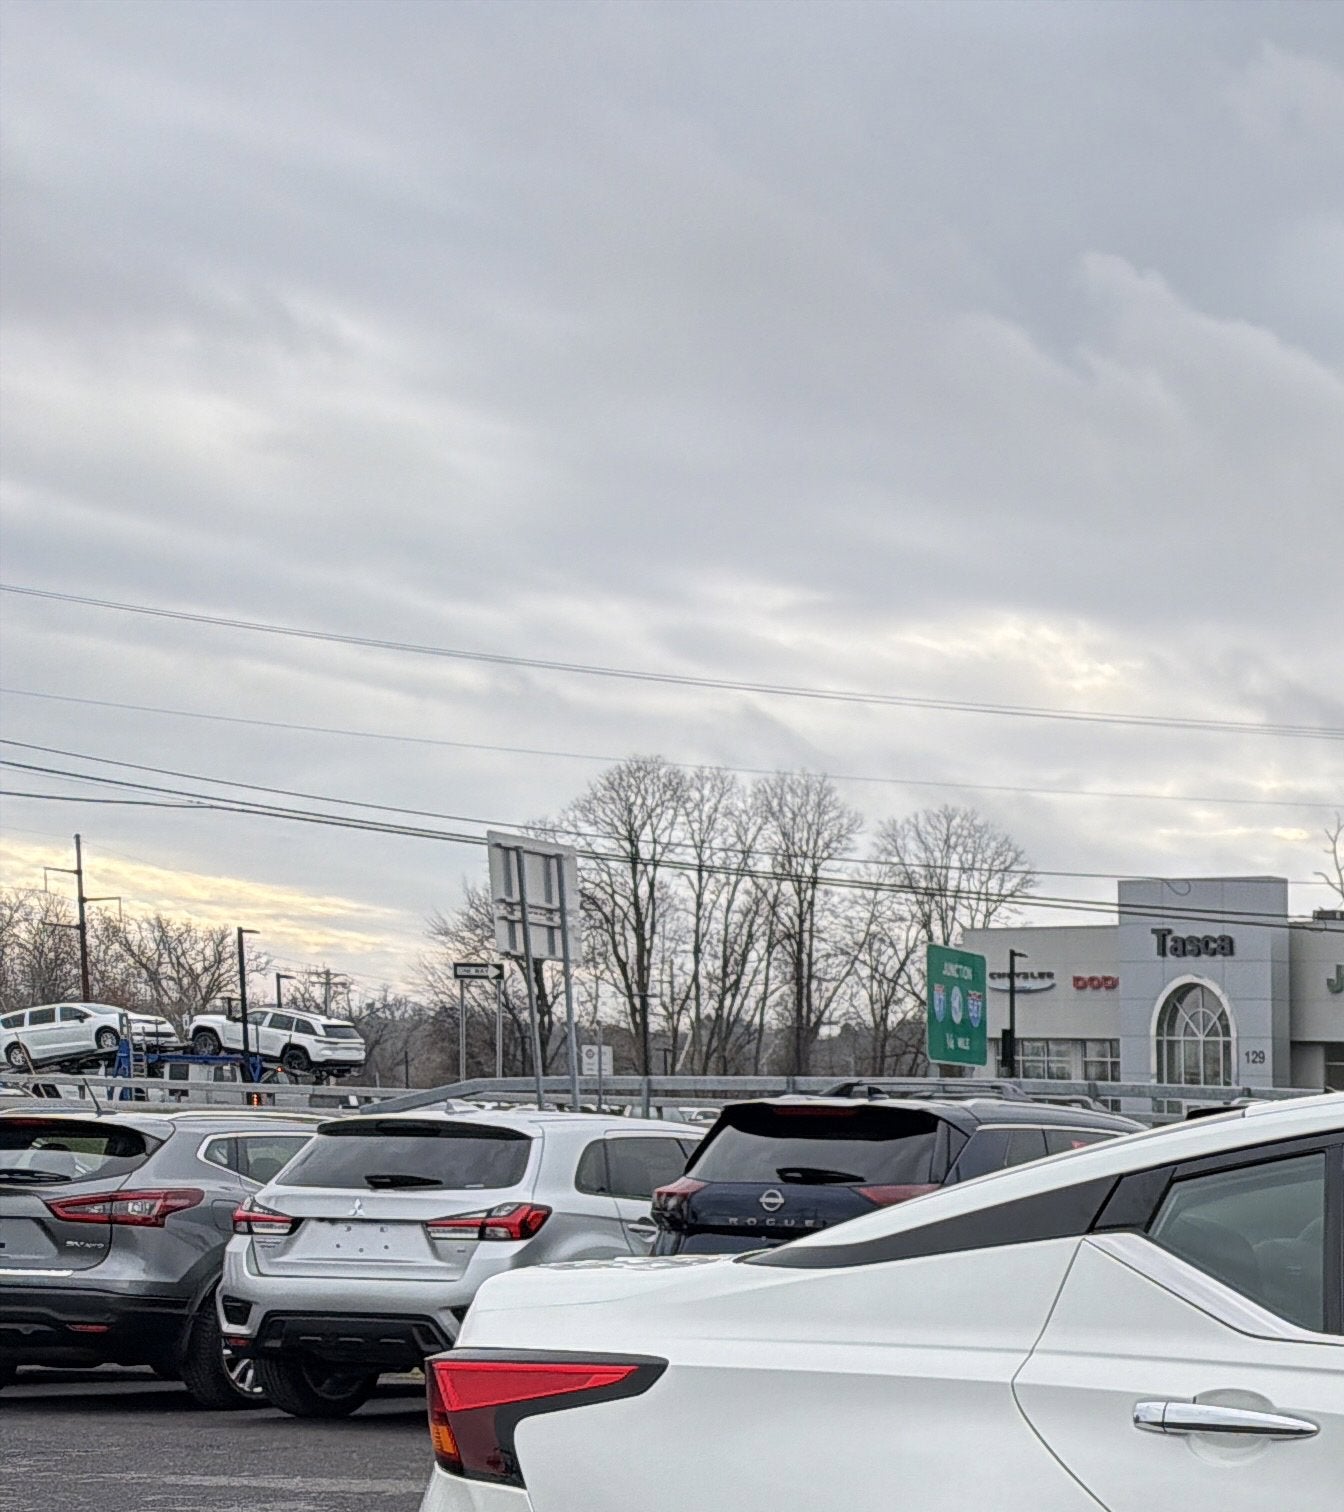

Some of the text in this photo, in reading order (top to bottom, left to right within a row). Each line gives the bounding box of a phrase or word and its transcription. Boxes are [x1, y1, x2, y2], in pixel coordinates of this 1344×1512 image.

[1151, 928, 1234, 957] Tasca
[1073, 975, 1120, 990] DOD
[1245, 1051, 1266, 1064] 129
[729, 1217, 815, 1227] ROGUE
